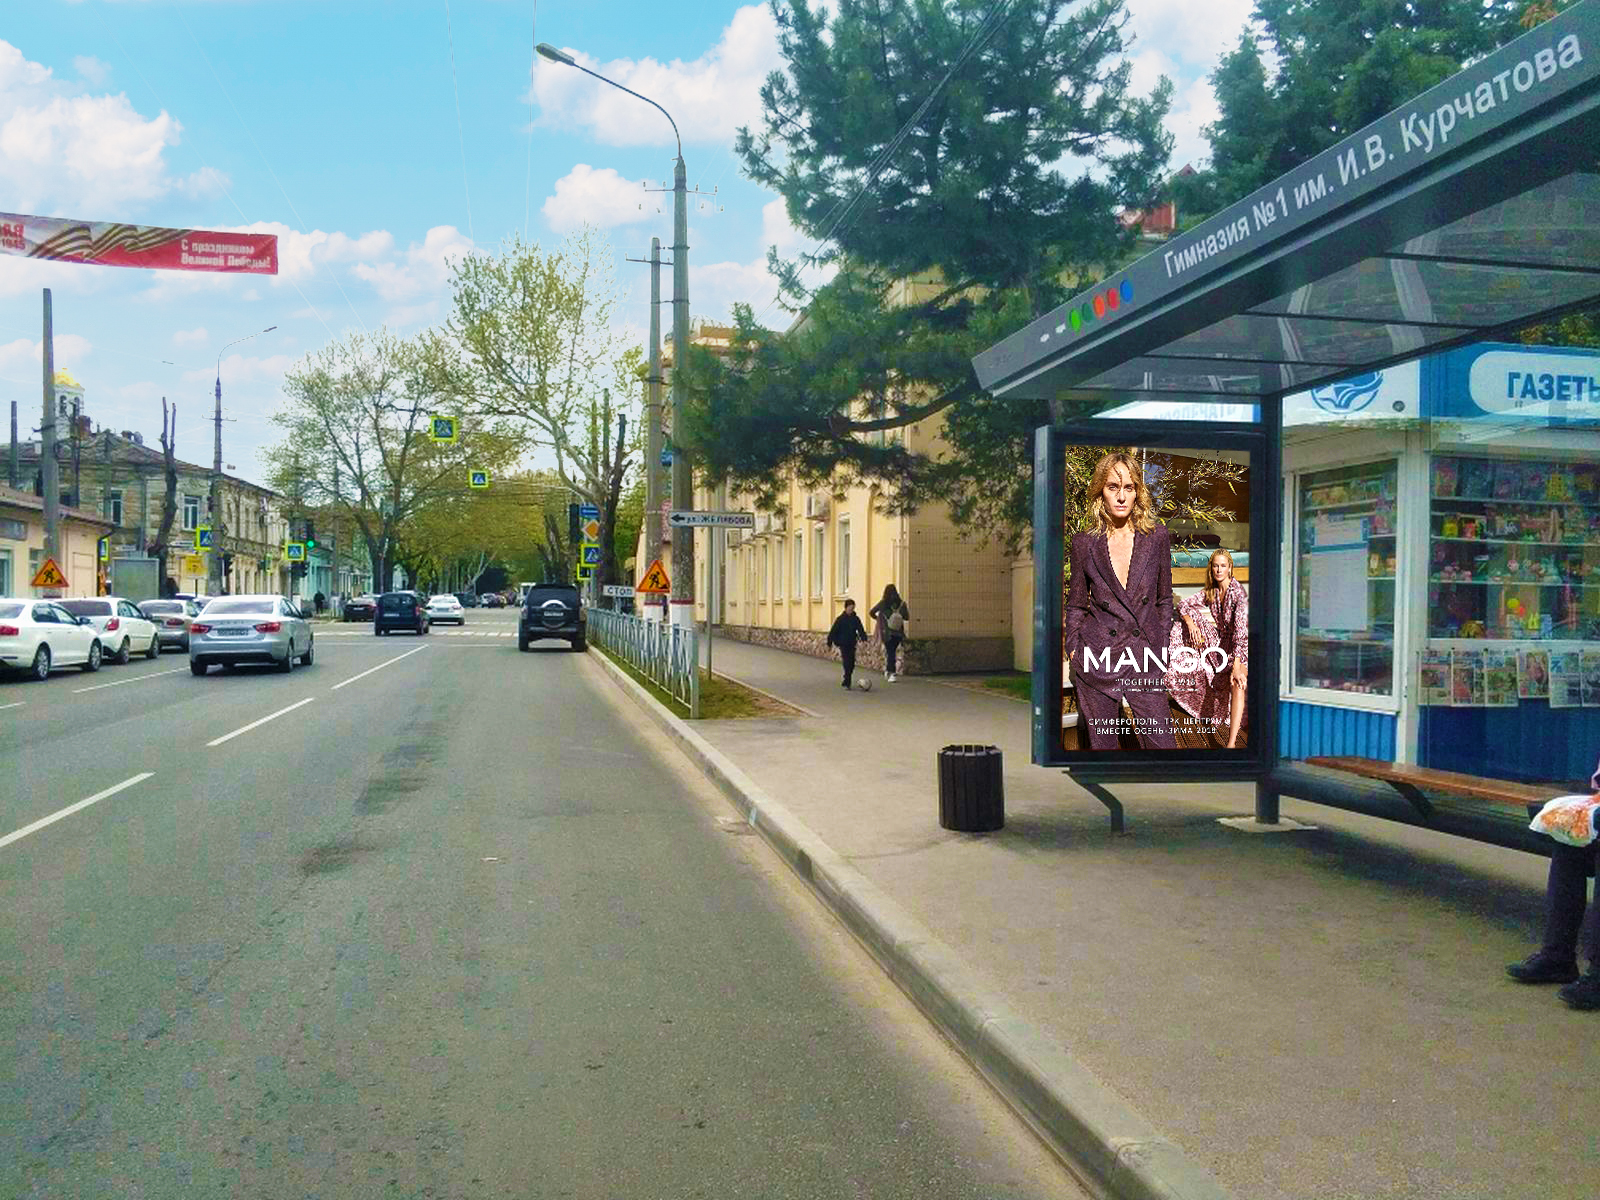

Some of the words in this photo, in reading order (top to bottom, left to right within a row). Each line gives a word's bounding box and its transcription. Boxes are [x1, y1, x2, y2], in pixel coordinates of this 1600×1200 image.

[1163, 215, 1250, 278] Гимназия
[1293, 173, 1335, 209] им.
[1399, 34, 1583, 153] Курчатова
[1083, 646, 1228, 673] MANGO
